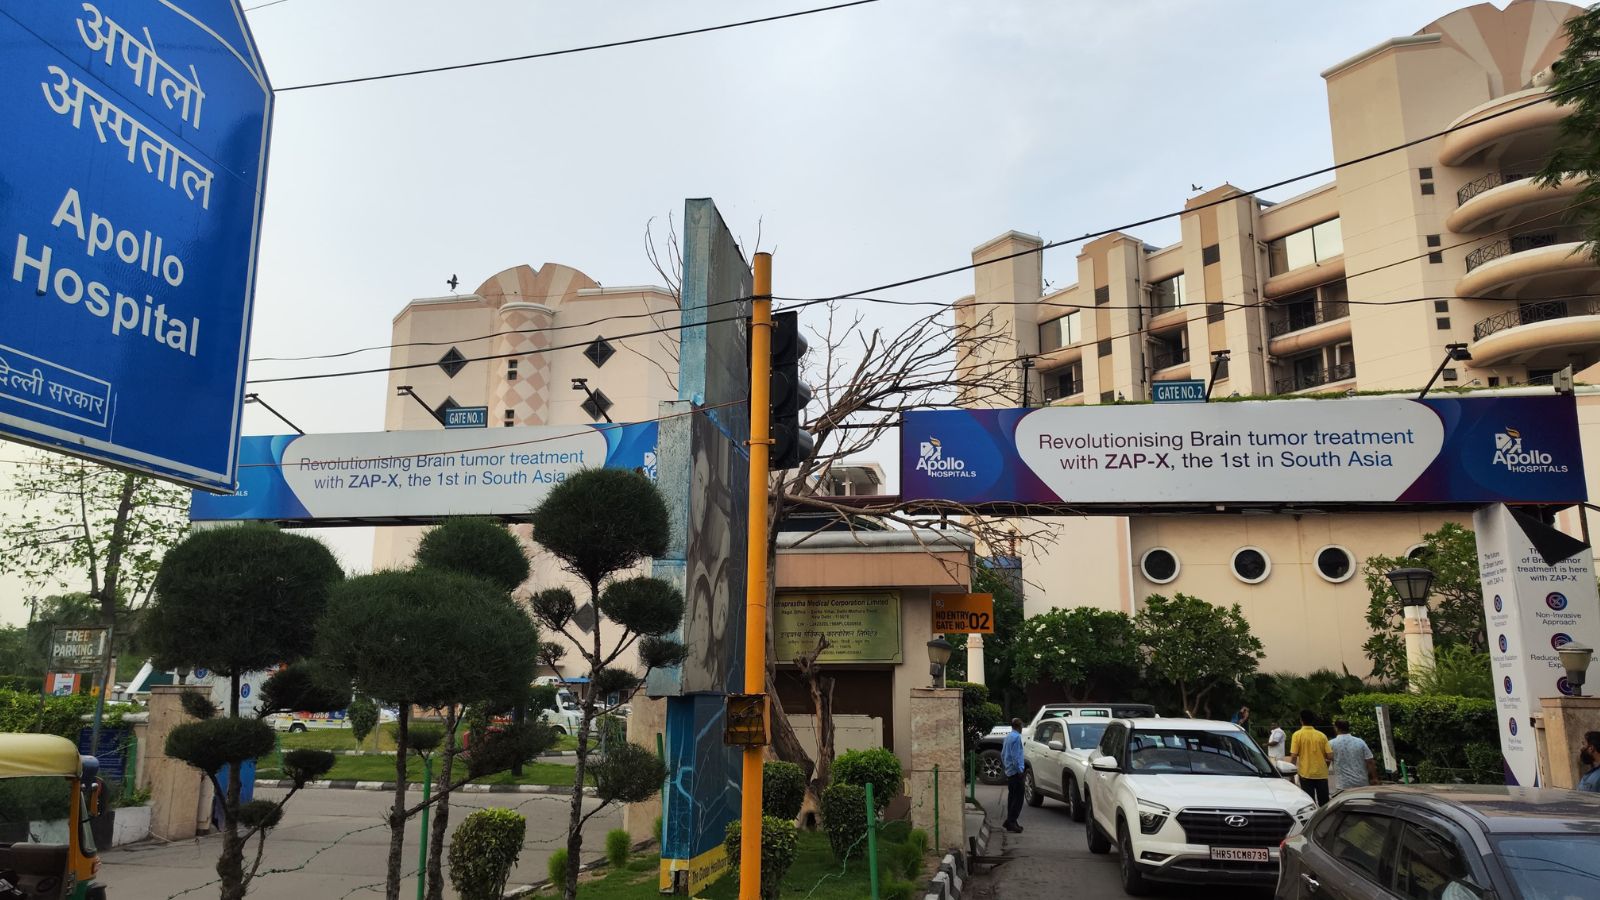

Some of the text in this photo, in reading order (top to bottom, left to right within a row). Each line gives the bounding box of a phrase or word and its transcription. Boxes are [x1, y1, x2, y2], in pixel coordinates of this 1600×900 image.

[76, 3, 205, 130] अपोलो
[41, 65, 214, 209] अस्पताल
[52, 187, 184, 287] Apollo
[12, 233, 200, 357] Hospital
[48, 380, 104, 415] सरकार
[1158, 386, 1203, 400] GATE NO. 2
[450, 411, 484, 424] GATE NO. 1
[1039, 429, 1414, 451] Revolutionising Brain tumor treatment
[300, 449, 584, 472] Revolutionising Brain tumor treatment
[916, 457, 965, 476] Apollo
[1060, 450, 1393, 471] with ZAP-X, the 1st in South Asia
[1492, 450, 1552, 471] Apollo
[931, 470, 977, 478] HOSPITALS
[1512, 465, 1568, 473] HOSPITALS
[314, 469, 566, 489] with ZAP-X, the 1st in South Asia
[1517, 565, 1557, 573] treatment
[1560, 565, 1566, 573] is
[1530, 574, 1577, 582] with ZAP-X
[947, 610, 970, 620] ENTRY
[969, 612, 990, 630] 02
[1536, 611, 1582, 619] Non-Invasive
[1542, 618, 1577, 626] Approach
[936, 620, 953, 630] GATE
[65, 630, 91, 642] FREE
[53, 643, 94, 657] PARKING
[1216, 850, 1267, 860] HR51CM8739
